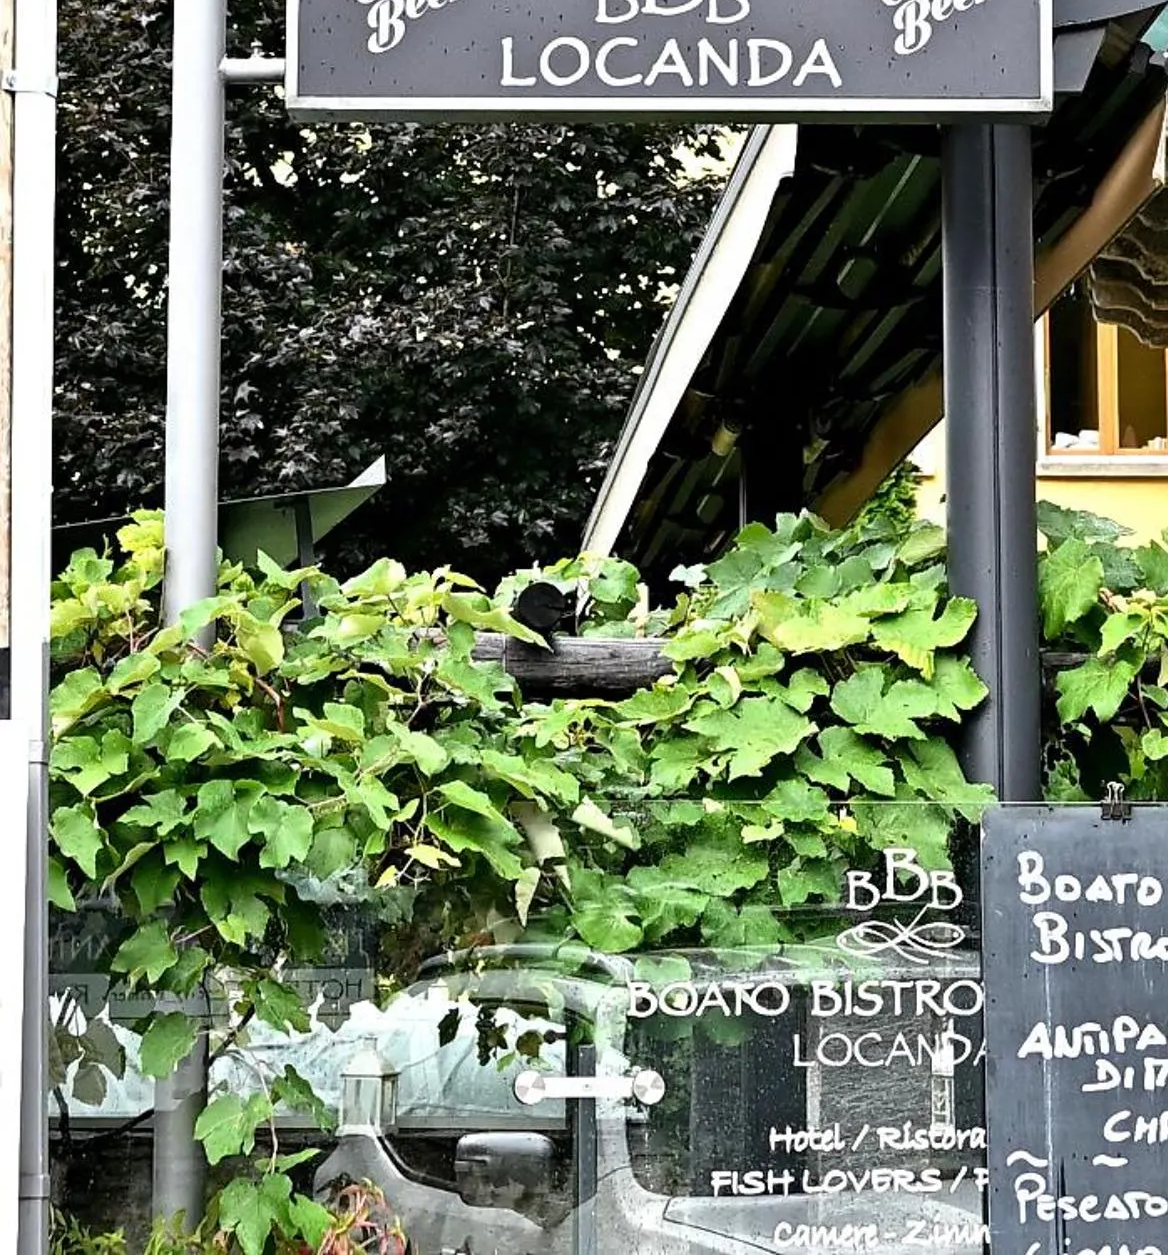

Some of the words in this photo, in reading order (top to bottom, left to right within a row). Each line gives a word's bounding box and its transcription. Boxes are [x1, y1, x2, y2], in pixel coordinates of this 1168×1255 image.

[501, 37, 842, 88] LOCANDA
[846, 848, 963, 911] BBB
[1017, 850, 1163, 906] BOATO
[626, 980, 791, 1017] BOATO
[811, 980, 986, 1017] BISTRO
[1081, 1059, 1135, 1092] DI
[769, 1123, 846, 1154] Hotel
[710, 1169, 795, 1197] FISH
[803, 1168, 943, 1194] LOVERS
